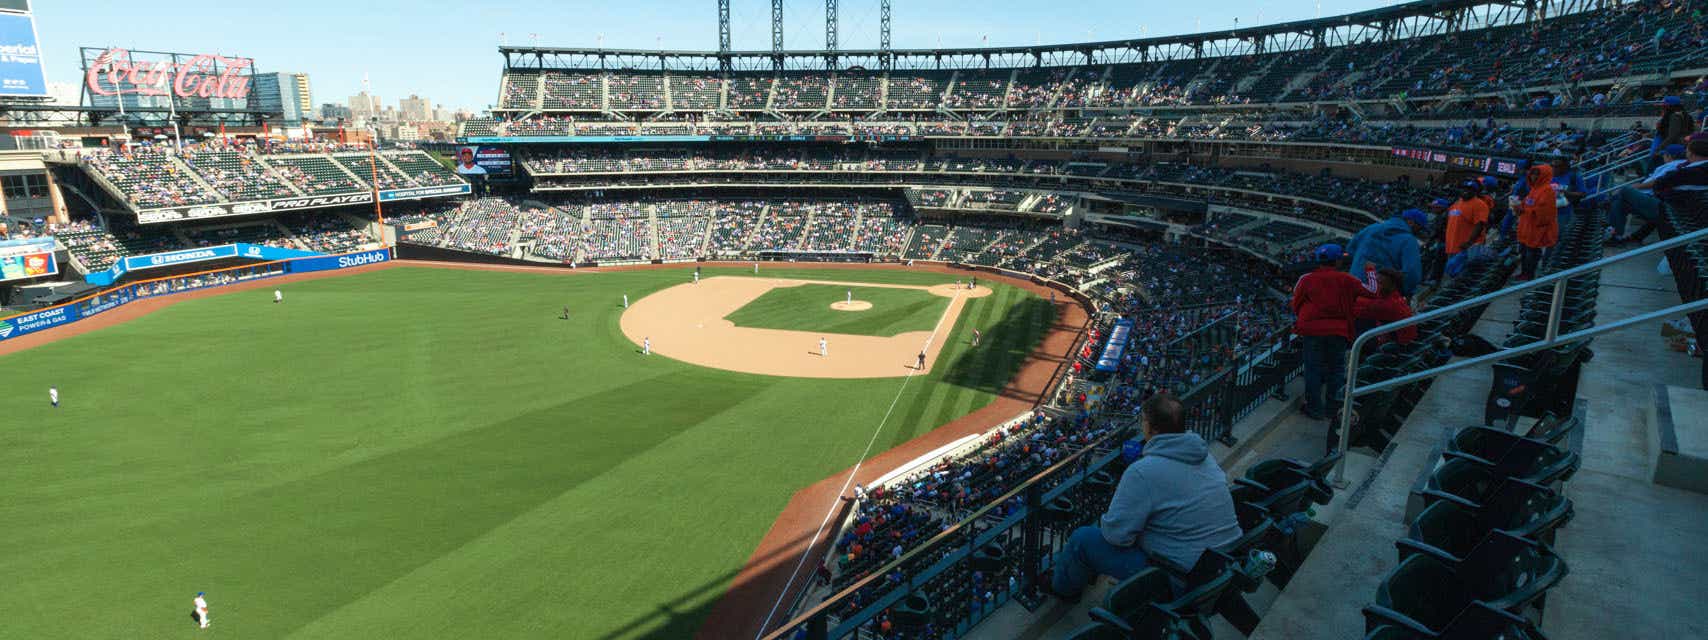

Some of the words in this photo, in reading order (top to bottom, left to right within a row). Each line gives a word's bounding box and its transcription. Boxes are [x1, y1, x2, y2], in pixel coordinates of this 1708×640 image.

[272, 200, 309, 209] PRO
[310, 195, 370, 205] PLAYER
[164, 250, 216, 262] HONDA
[338, 252, 384, 267] StubHub
[17, 312, 39, 324] EAST
[39, 308, 64, 319] COAST
[19, 319, 45, 331] POWER
